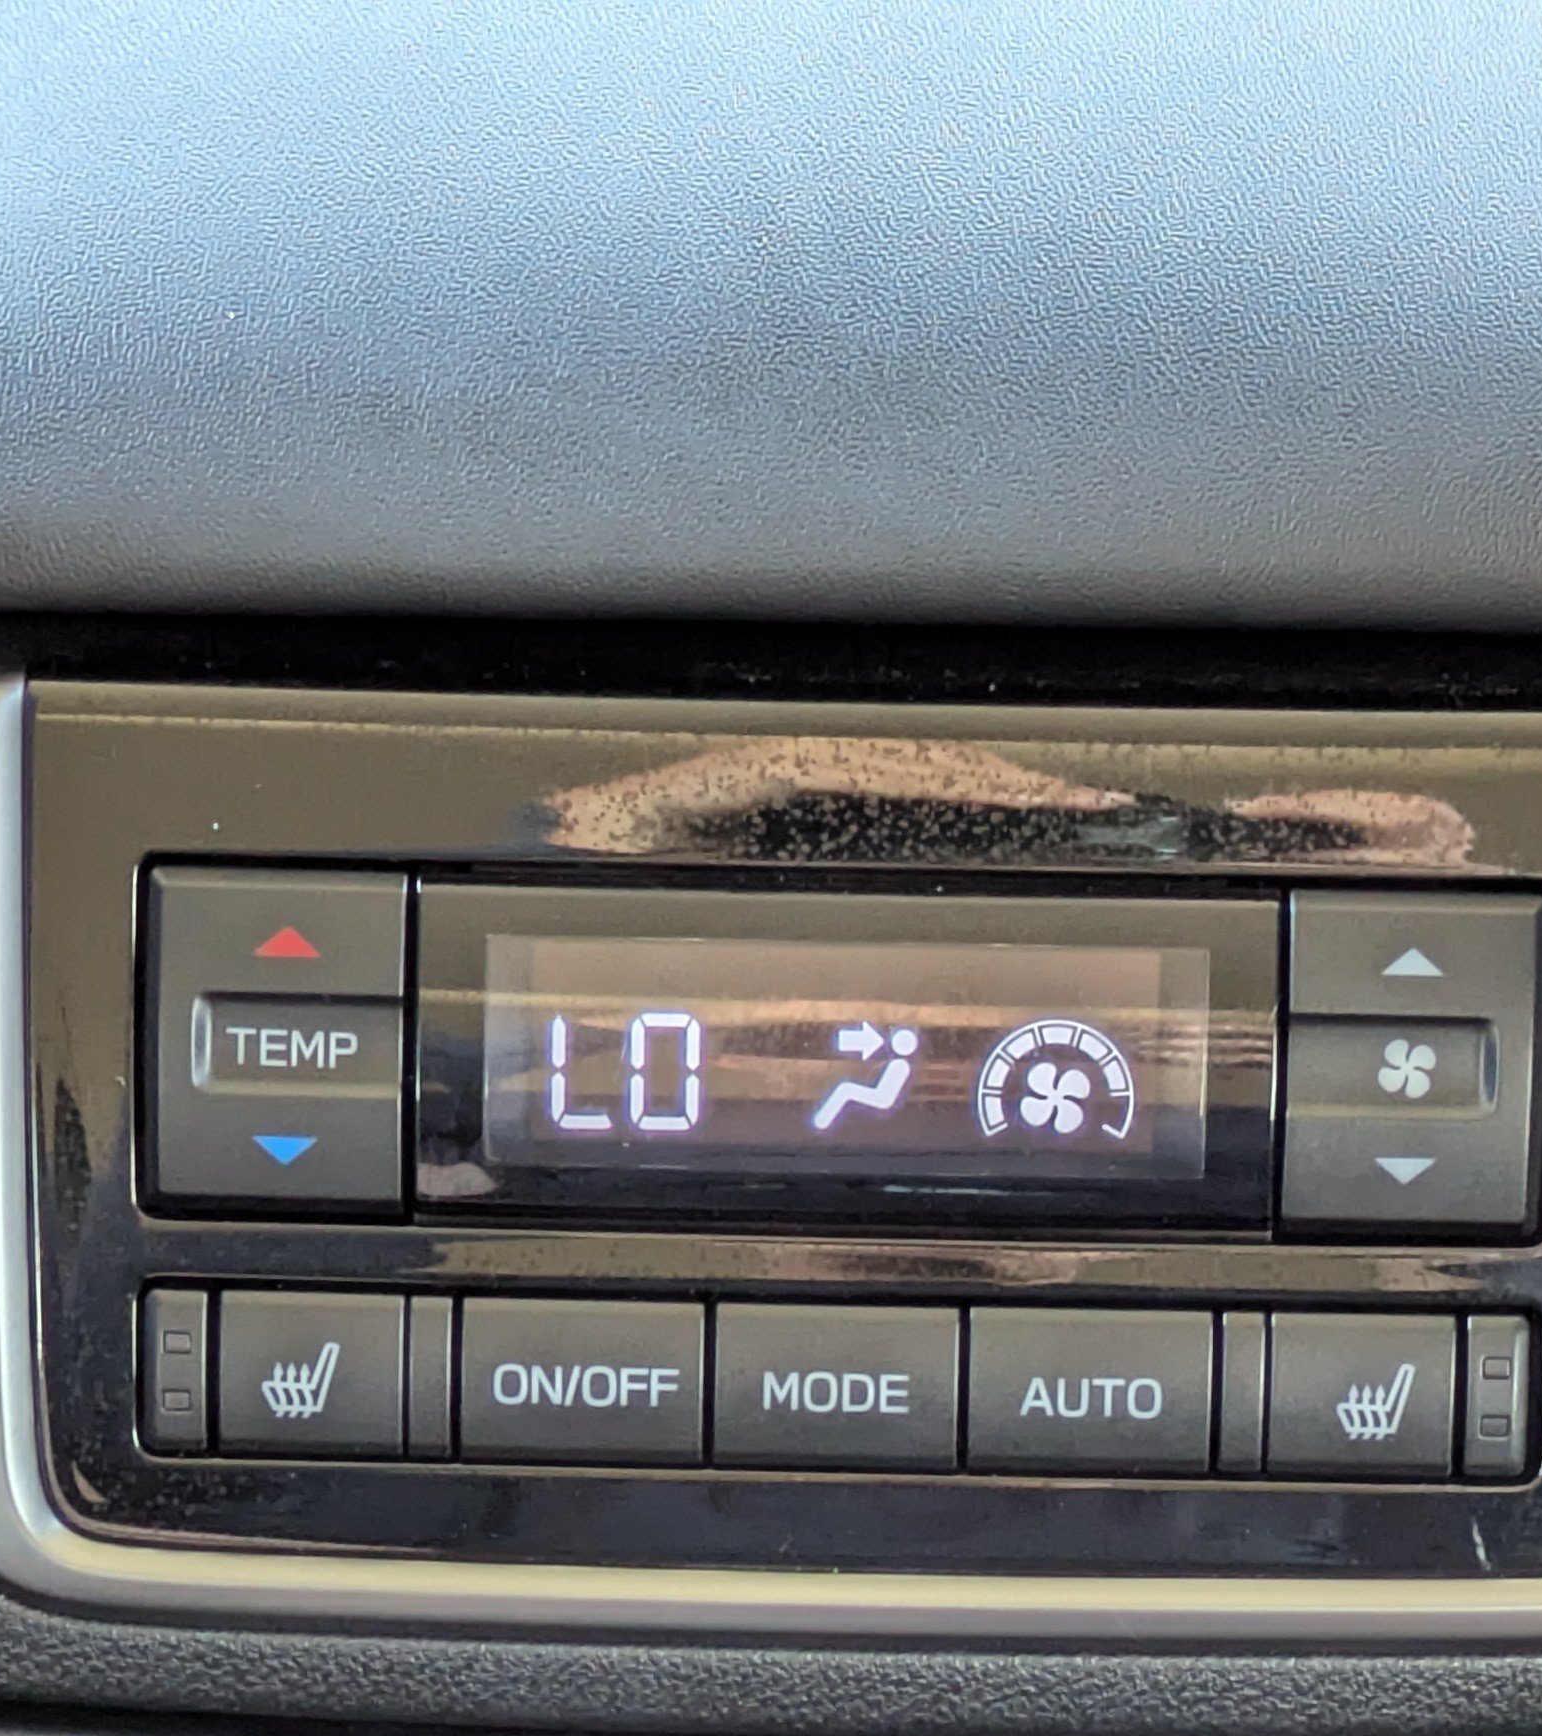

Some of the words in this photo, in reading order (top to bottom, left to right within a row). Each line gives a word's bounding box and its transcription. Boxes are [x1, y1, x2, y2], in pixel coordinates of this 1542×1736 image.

[225, 1025, 360, 1070] TEMP
[491, 1362, 681, 1409] ON/OFF
[762, 1369, 911, 1415] MODE
[1019, 1375, 1164, 1420] AUTO
